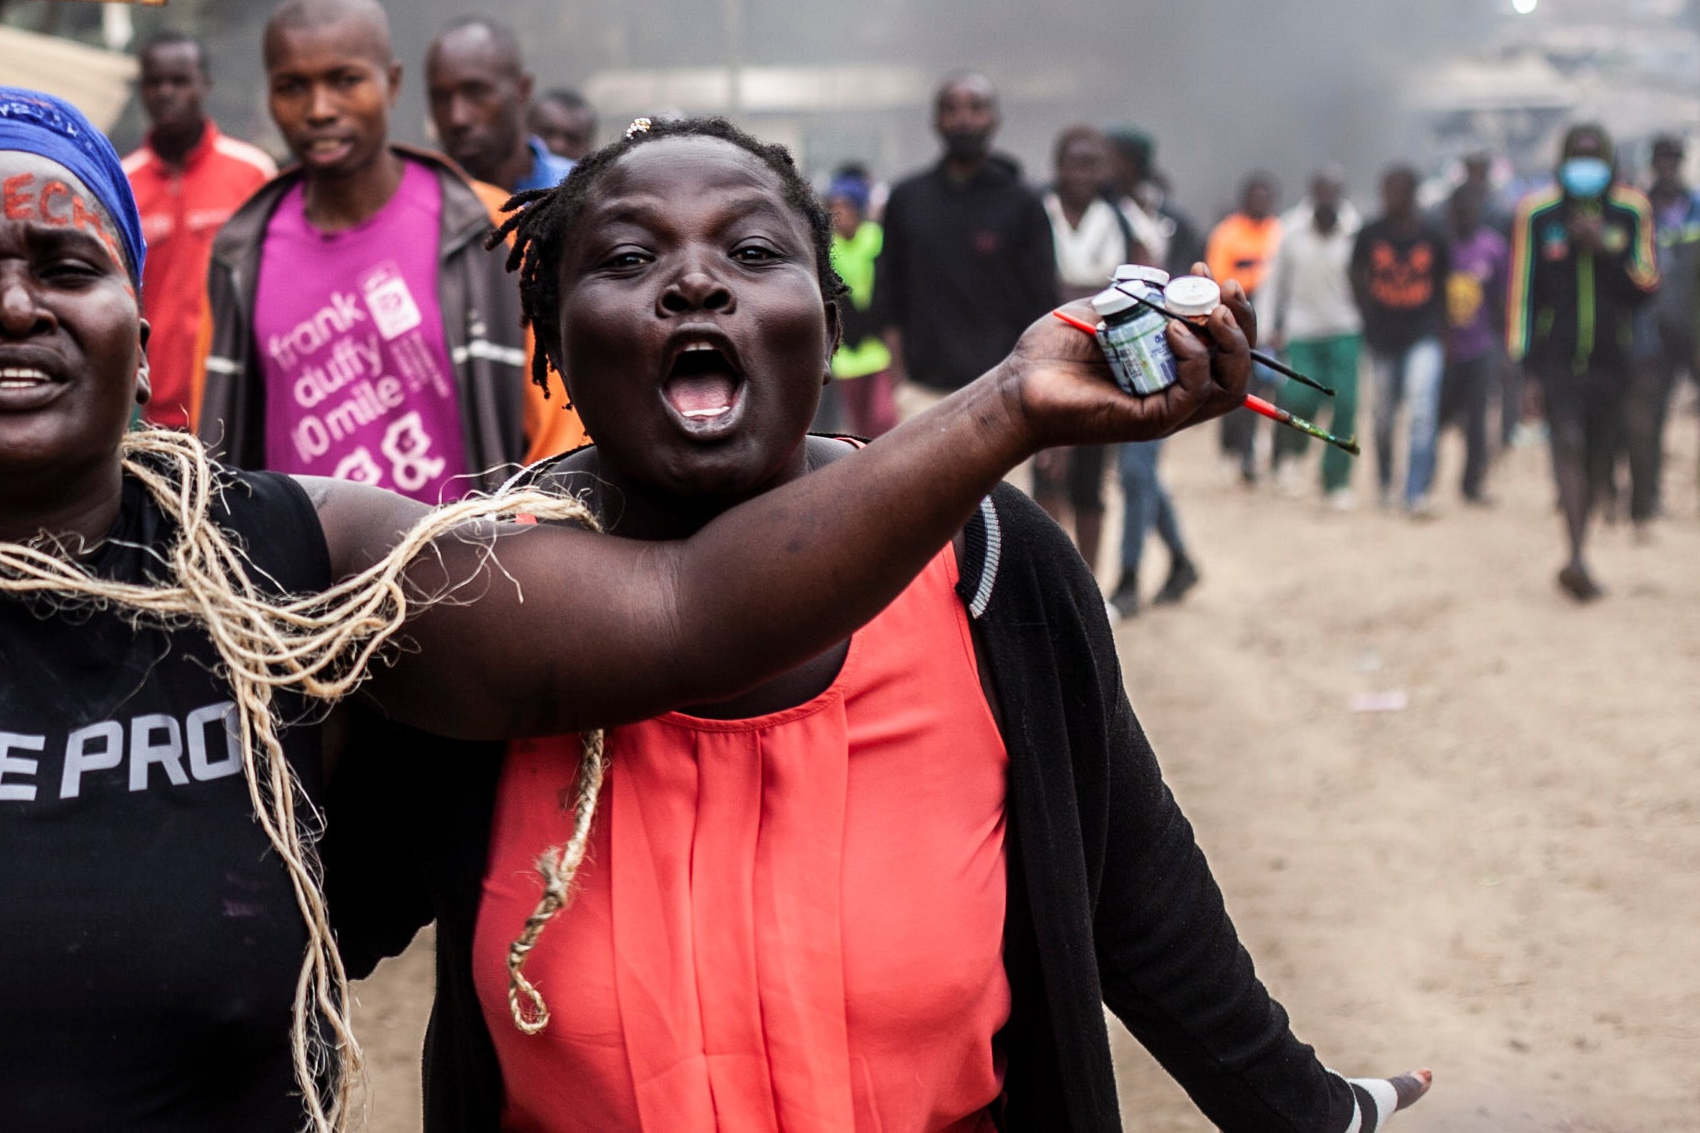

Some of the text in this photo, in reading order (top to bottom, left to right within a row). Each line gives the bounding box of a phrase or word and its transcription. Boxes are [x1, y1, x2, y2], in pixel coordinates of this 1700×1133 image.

[268, 291, 366, 370] frank
[293, 333, 383, 408] duffy
[325, 376, 405, 441] mile
[59, 700, 243, 800] PRO
